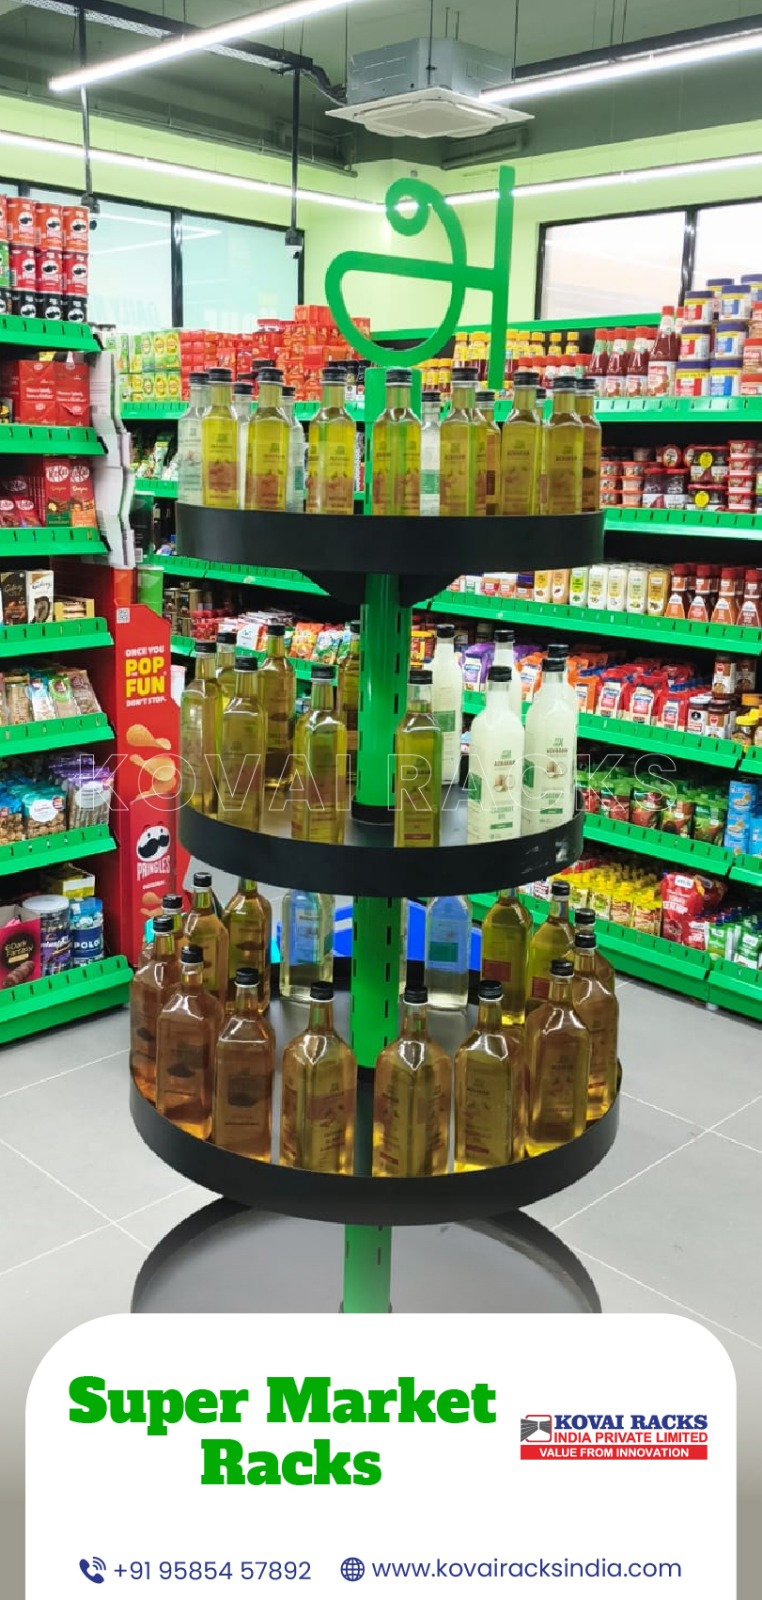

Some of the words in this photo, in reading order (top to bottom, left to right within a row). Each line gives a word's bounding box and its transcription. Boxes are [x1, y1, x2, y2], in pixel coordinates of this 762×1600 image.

[125, 647, 147, 657] ONCE
[147, 645, 165, 654] YOU
[125, 656, 165, 677] POP
[126, 676, 165, 697] FUN
[137, 855, 170, 881] PRINGLES
[74, 941, 100, 949] POLO
